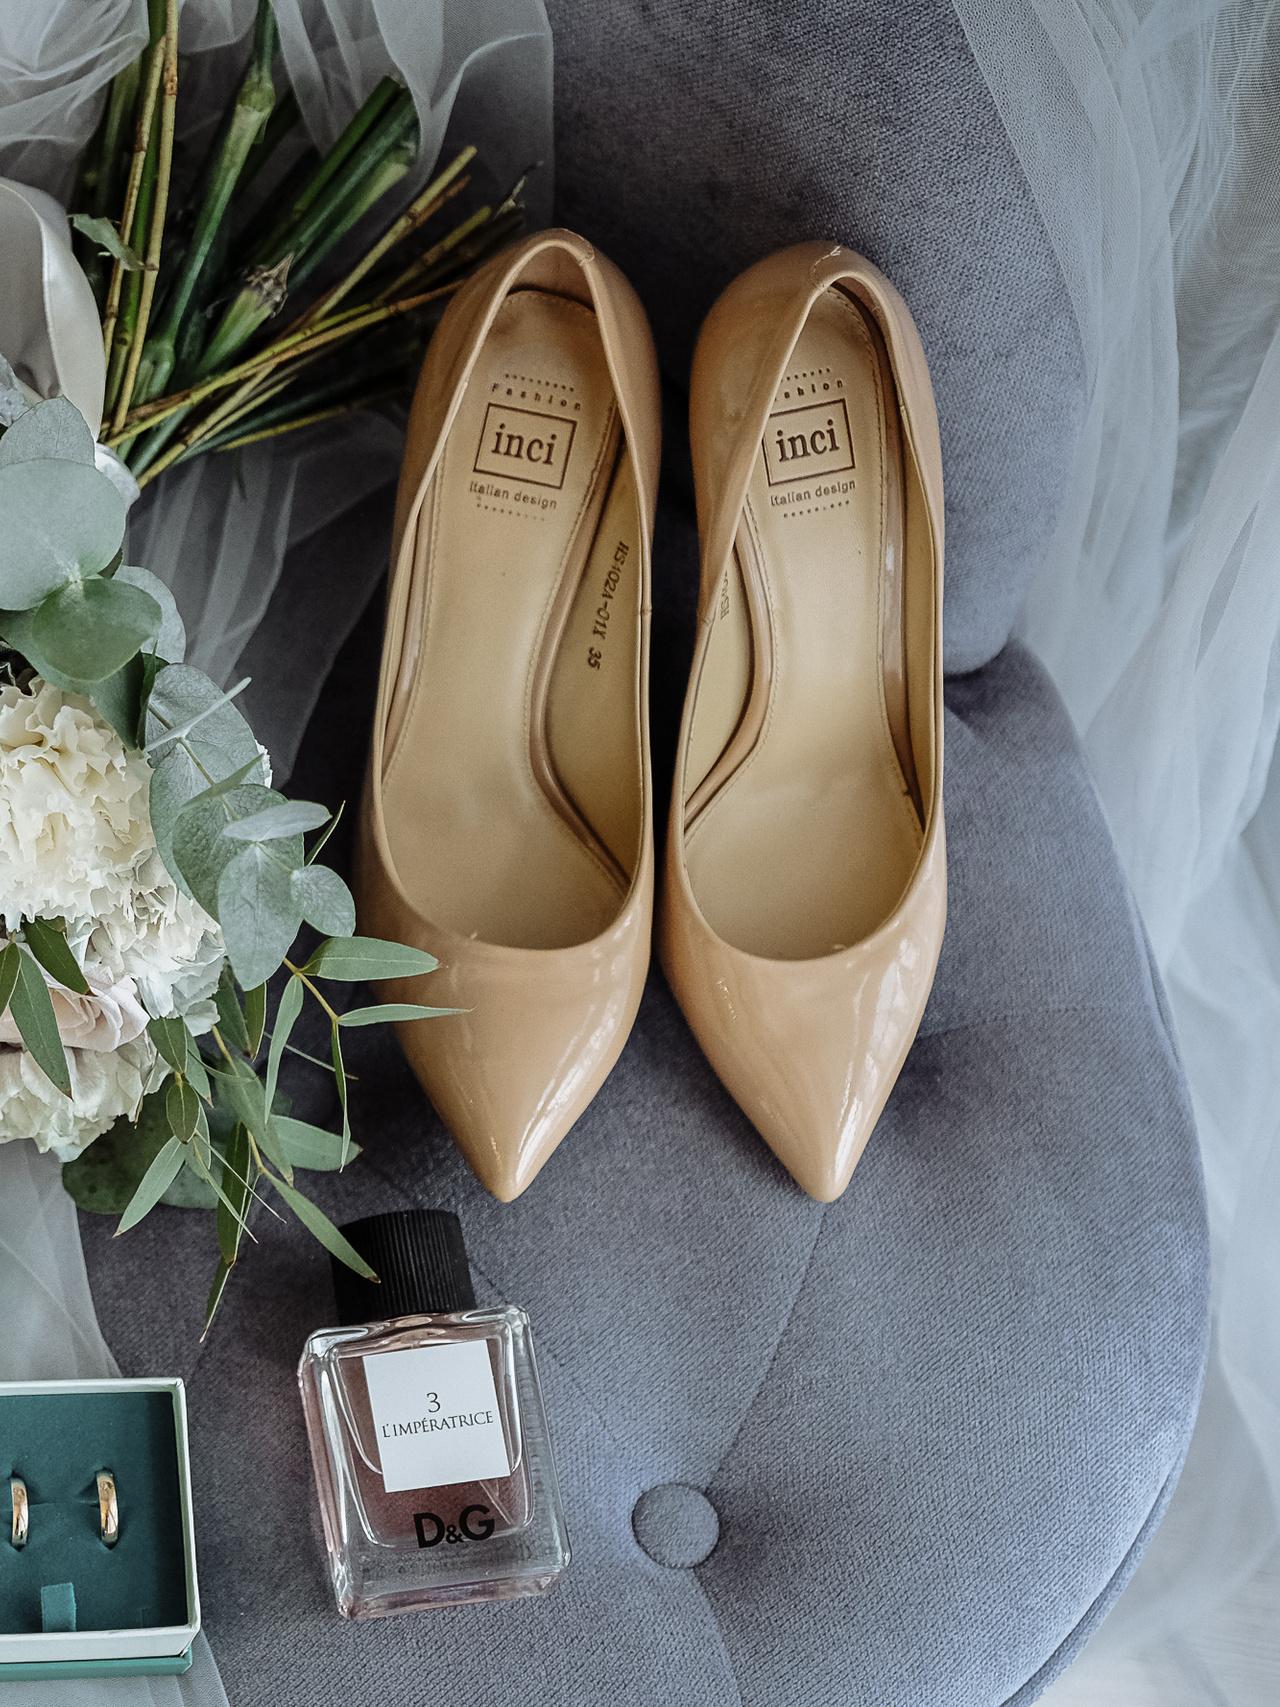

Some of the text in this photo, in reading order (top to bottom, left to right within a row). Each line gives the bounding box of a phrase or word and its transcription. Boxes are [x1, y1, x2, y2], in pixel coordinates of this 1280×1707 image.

[491, 382, 582, 411] Fashion
[490, 422, 558, 466] inci
[775, 418, 840, 463] inci
[469, 480, 558, 510] Italian design
[770, 480, 856, 507] Italian design
[587, 646, 603, 671] 35
[426, 1391, 441, 1413] 3
[381, 1410, 494, 1439] L'IMPÉRATRICE
[413, 1504, 496, 1549] D&G
